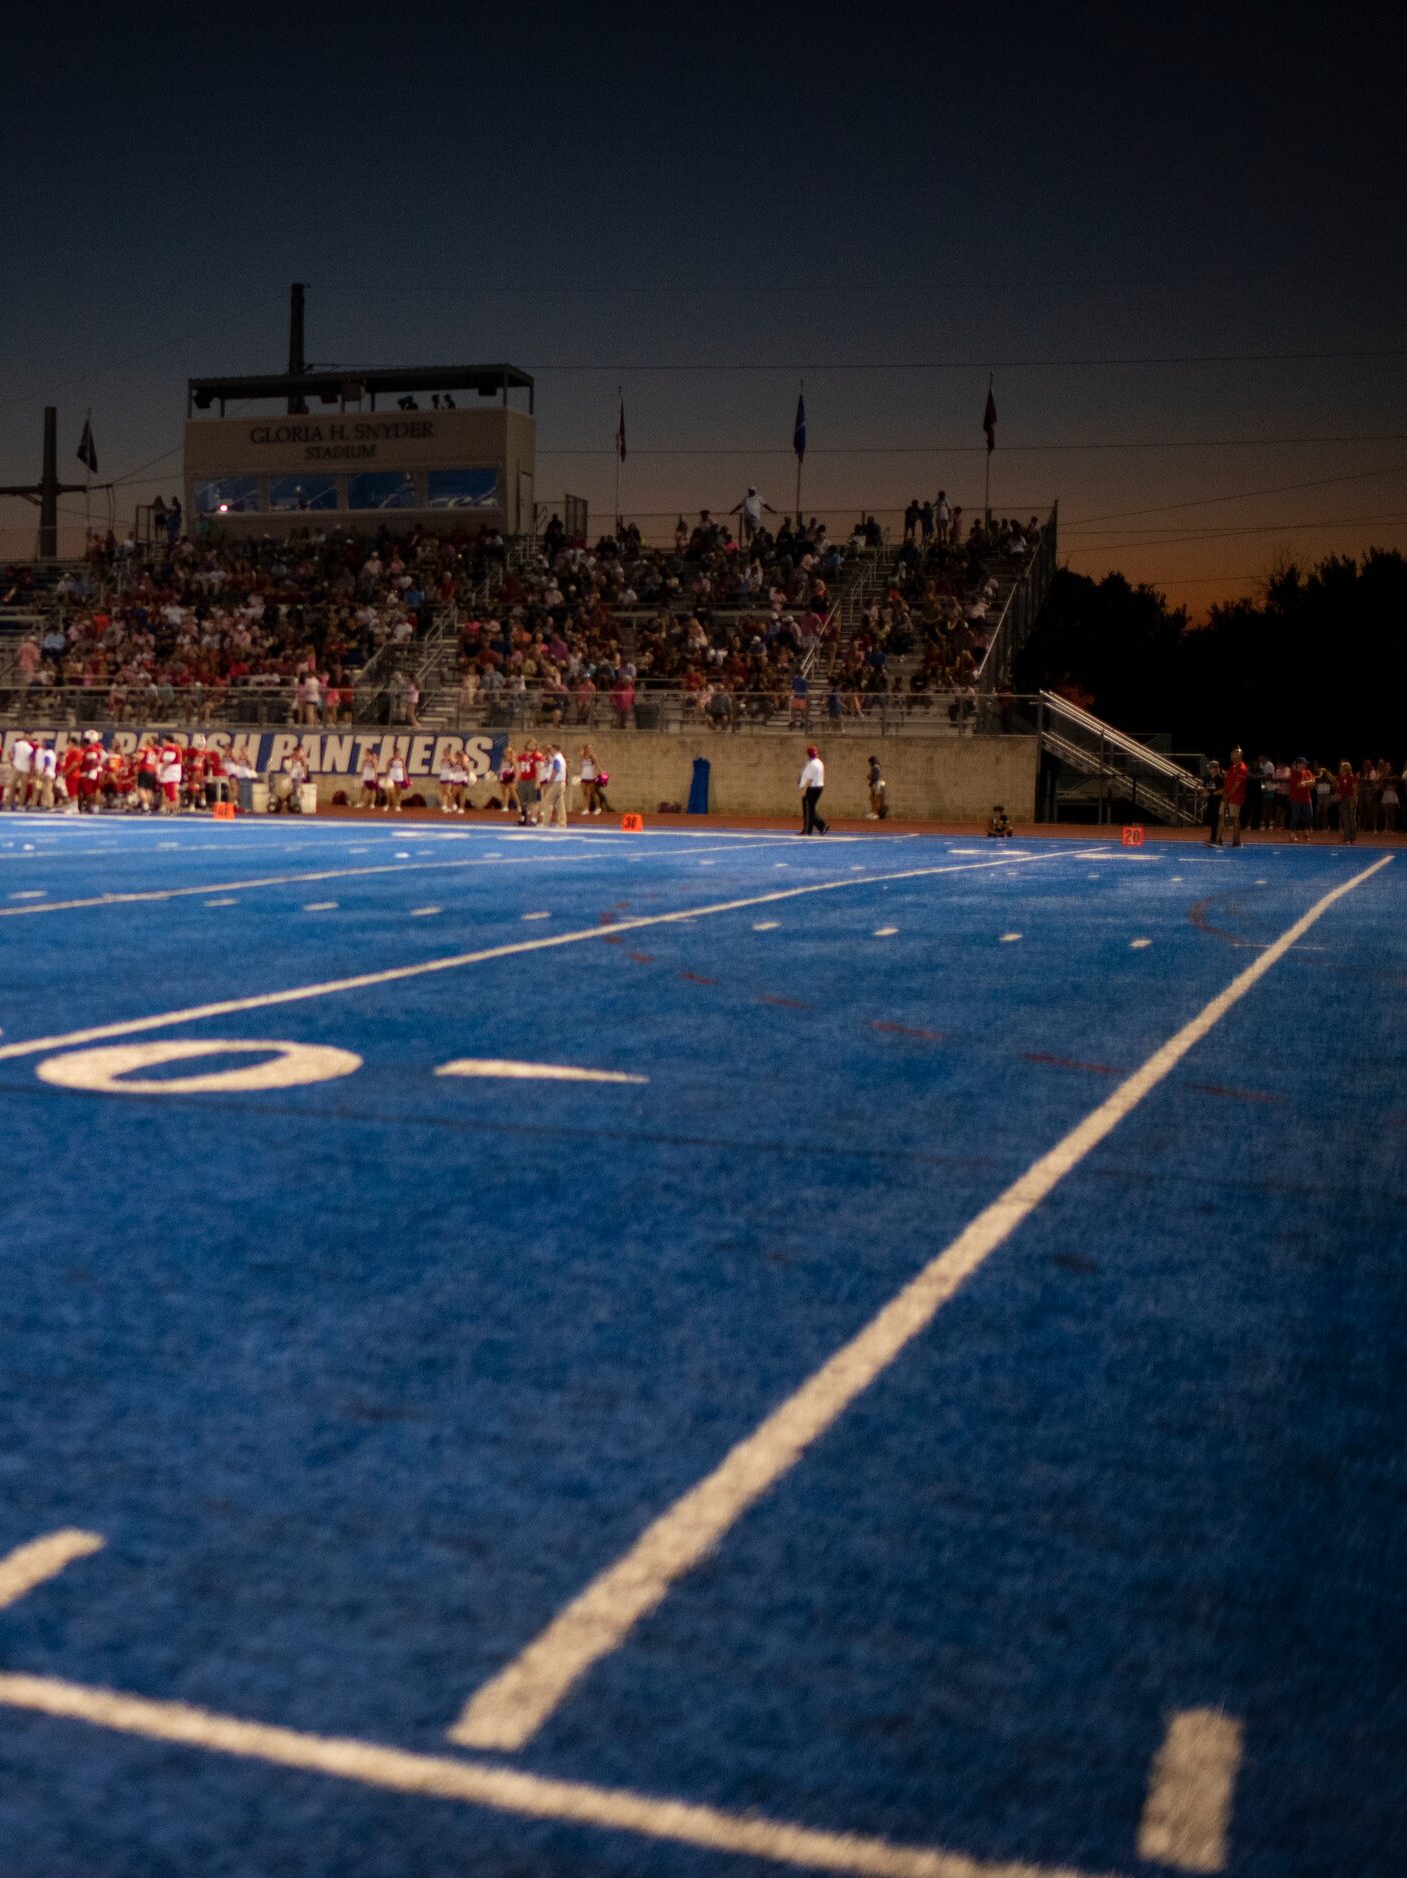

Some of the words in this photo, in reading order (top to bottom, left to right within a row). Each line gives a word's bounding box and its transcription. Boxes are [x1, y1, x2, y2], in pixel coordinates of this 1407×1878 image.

[251, 425, 322, 444] GLORIA
[330, 423, 350, 441] H.
[355, 421, 434, 440] SNYDER
[306, 446, 376, 461] STADIUM
[110, 731, 262, 770] PARSH
[270, 734, 495, 776] PANTHERS
[1126, 829, 1140, 843] 20
